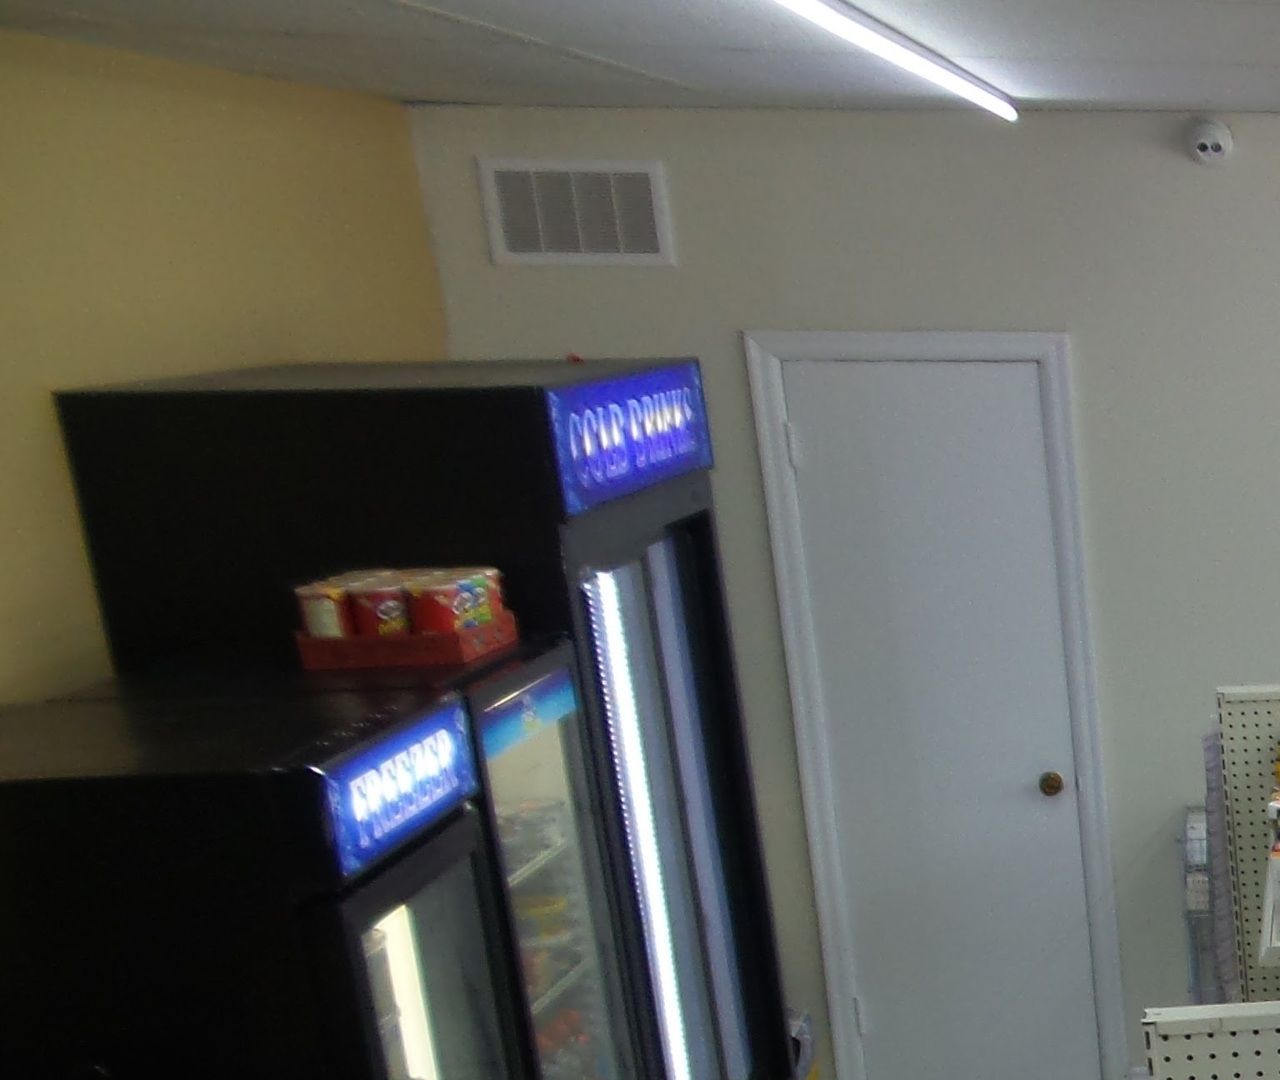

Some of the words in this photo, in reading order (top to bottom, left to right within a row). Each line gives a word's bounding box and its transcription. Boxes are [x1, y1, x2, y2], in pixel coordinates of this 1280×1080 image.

[568, 403, 630, 488] COLD
[626, 386, 696, 468] DRINKS
[349, 728, 460, 849] FREEZER
